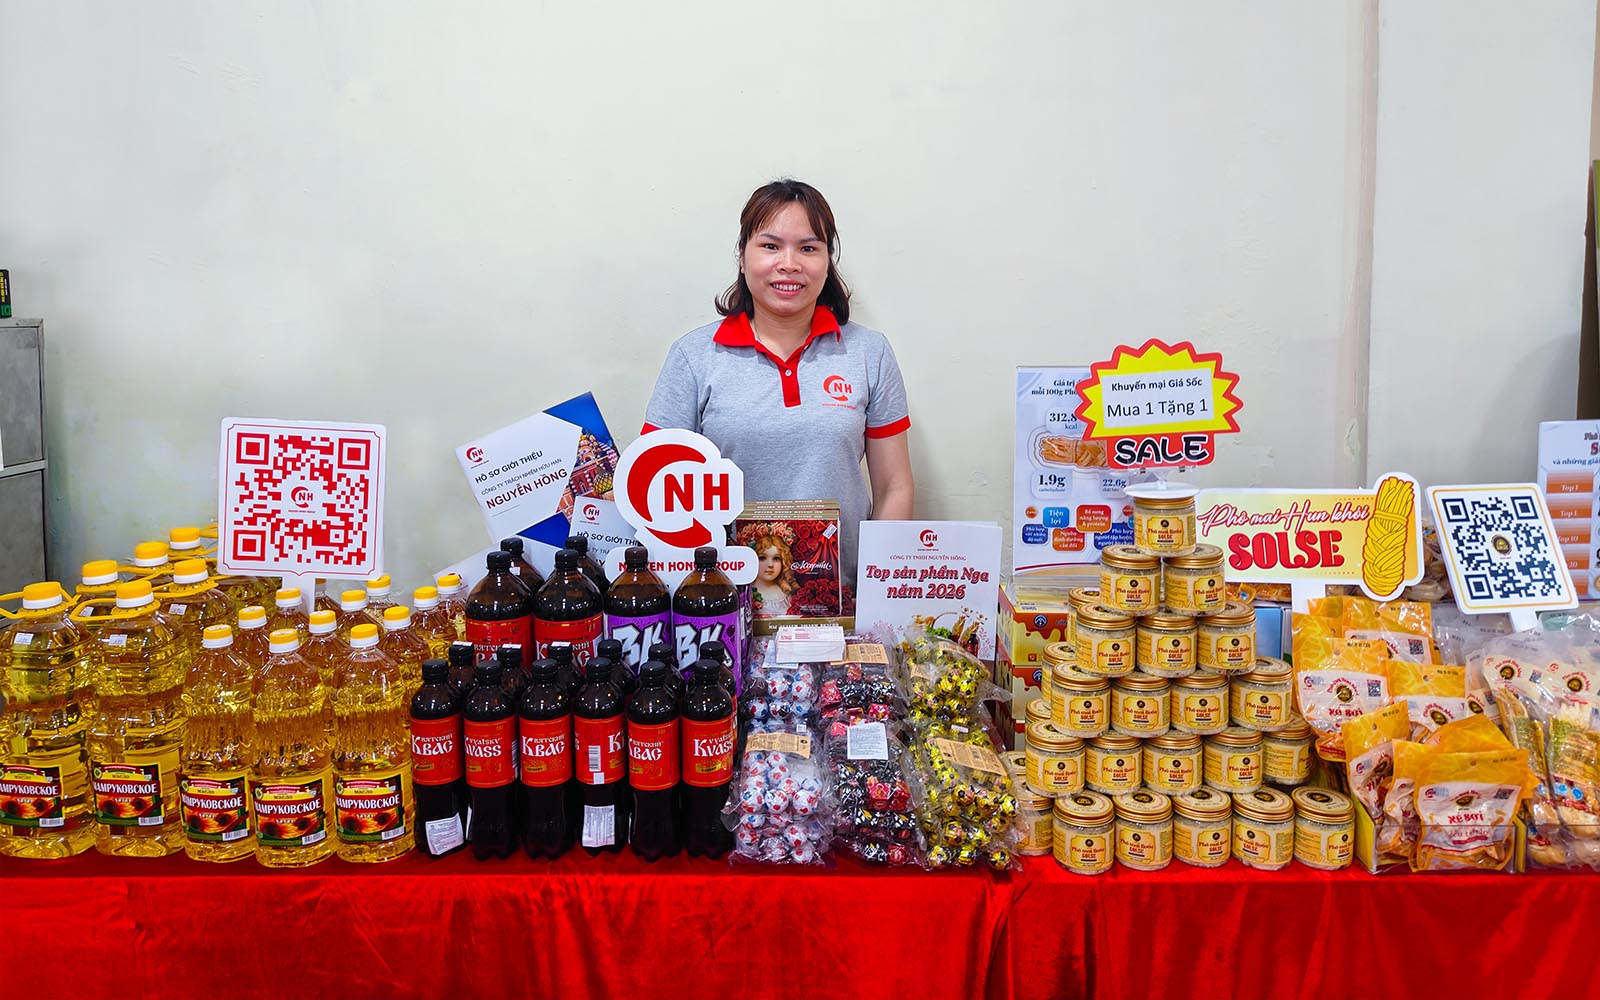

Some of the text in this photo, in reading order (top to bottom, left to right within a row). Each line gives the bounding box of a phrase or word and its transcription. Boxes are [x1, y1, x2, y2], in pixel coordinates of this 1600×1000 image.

[1031, 386, 1045, 395] mỗi
[1046, 388, 1063, 397] 100g
[1111, 376, 1202, 392] Khuyến mại Giá Sốc
[1107, 398, 1208, 417] Mua 1 Tặng 1
[1115, 436, 1208, 465] SALE
[1590, 442, 1600, 455] S
[475, 472, 488, 484] HỒ
[488, 467, 501, 478] SƠ
[501, 461, 520, 473] GIỚI
[519, 450, 543, 465] THIỆU
[1562, 457, 1587, 465] những
[485, 468, 568, 509] NGUYỄN HỒNG
[1039, 474, 1066, 488] 1.9g
[1102, 478, 1127, 488] 22.6g
[1197, 499, 1369, 537] Phô mai Hun khói
[1559, 510, 1574, 518] Top
[591, 533, 604, 541] SƠ
[605, 535, 623, 544] GIỚI
[624, 538, 638, 546] THI
[1228, 530, 1345, 571] SOLSE
[618, 561, 745, 572] NEN HON ROUP
[866, 564, 990, 584] Top sản phẩm Nga
[887, 583, 967, 600] năm 2026
[473, 644, 499, 652] ВЯТС
[0, 783, 59, 795] АМРУКОВСКОЕ
[94, 781, 158, 794] АМРУКОВСКОЕ
[254, 798, 322, 815] АМРУКОВСКОЕ
[336, 794, 401, 810] АМРУКОВСКОЕ
